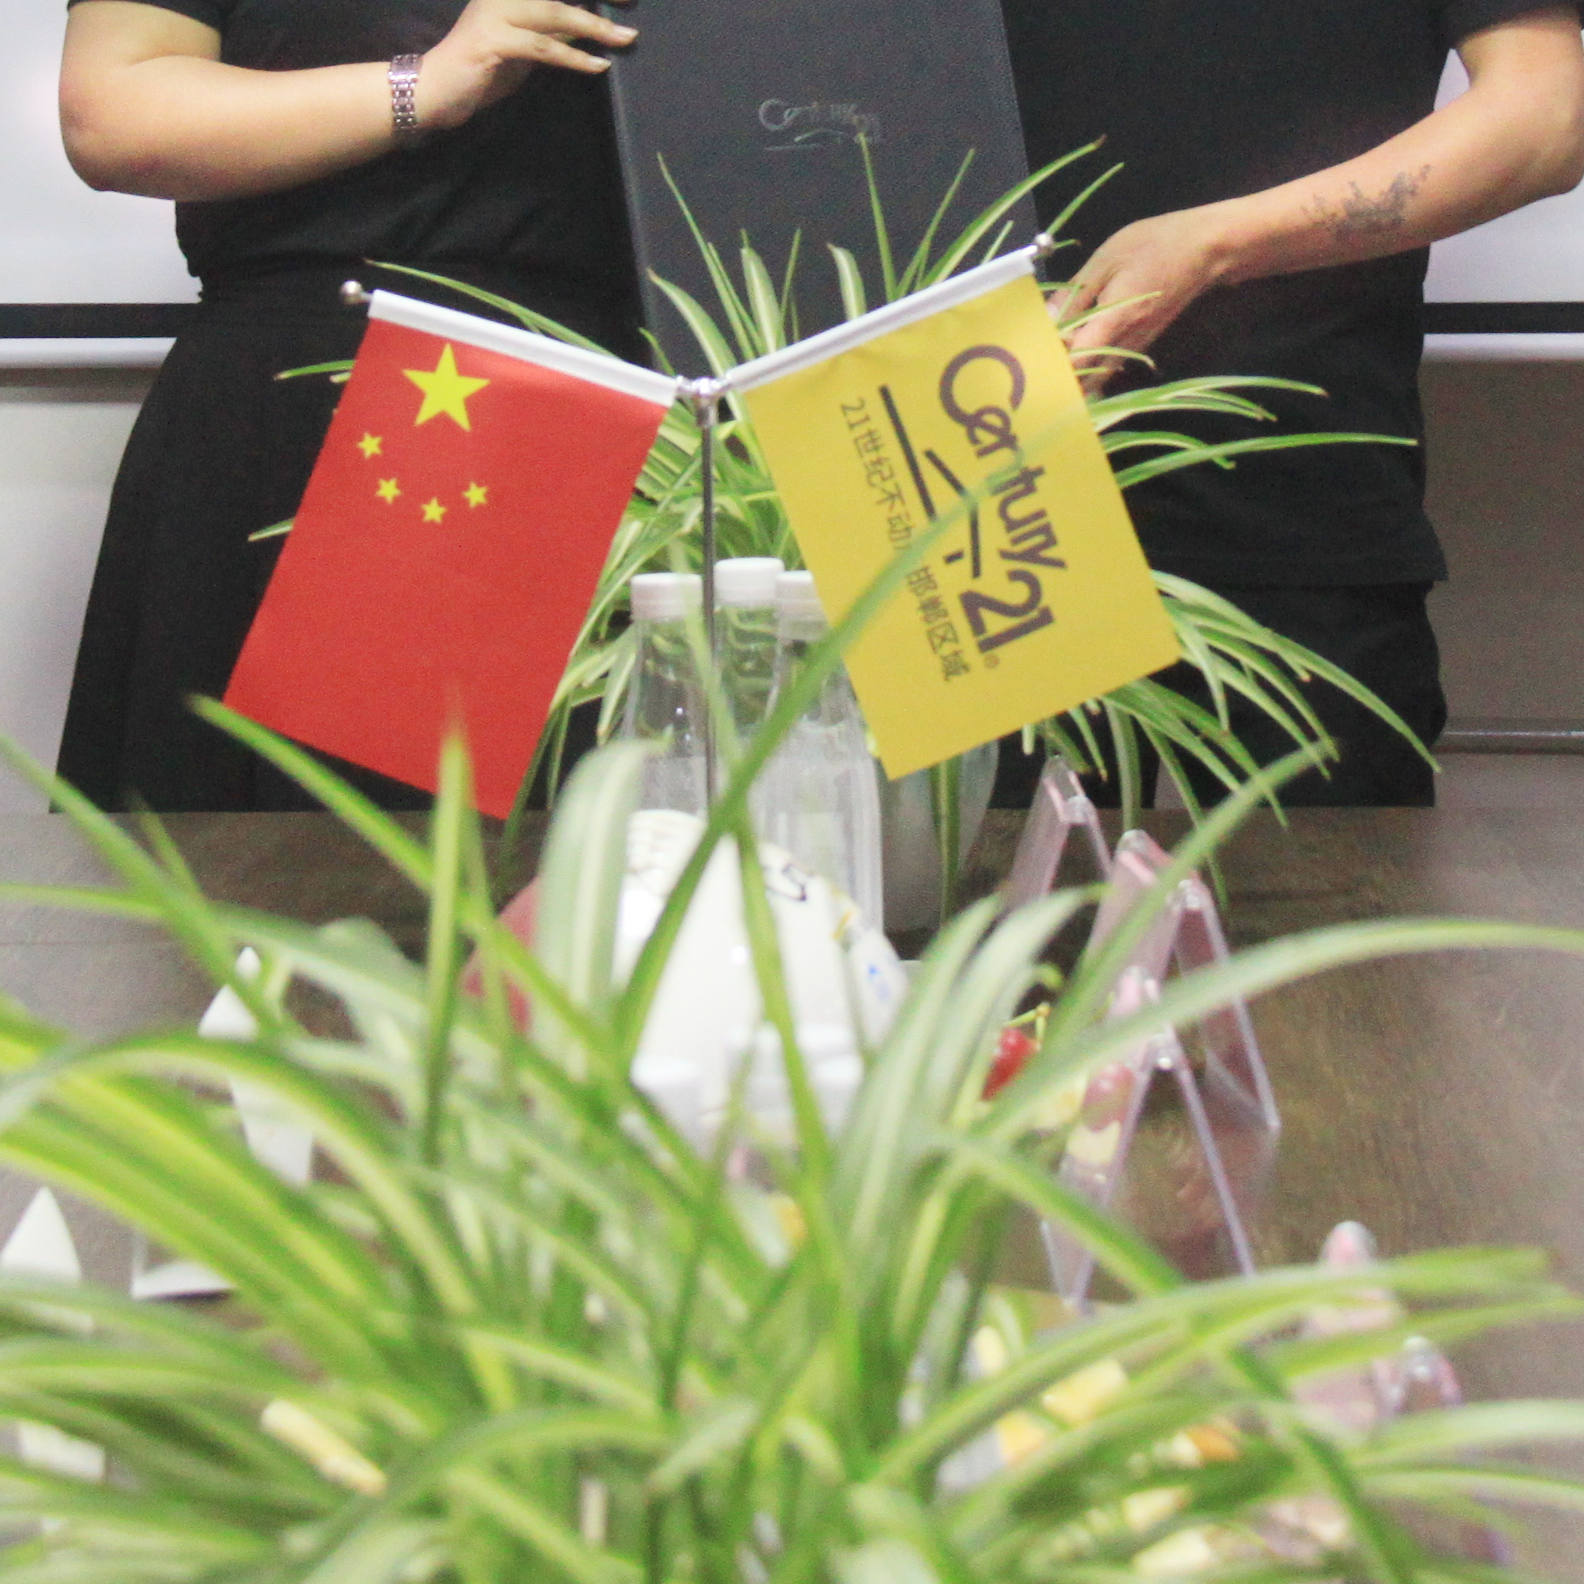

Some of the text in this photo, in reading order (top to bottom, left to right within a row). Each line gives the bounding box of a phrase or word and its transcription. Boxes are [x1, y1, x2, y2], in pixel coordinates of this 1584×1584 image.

[841, 397, 971, 683] 21世纪不动邯郸区域
